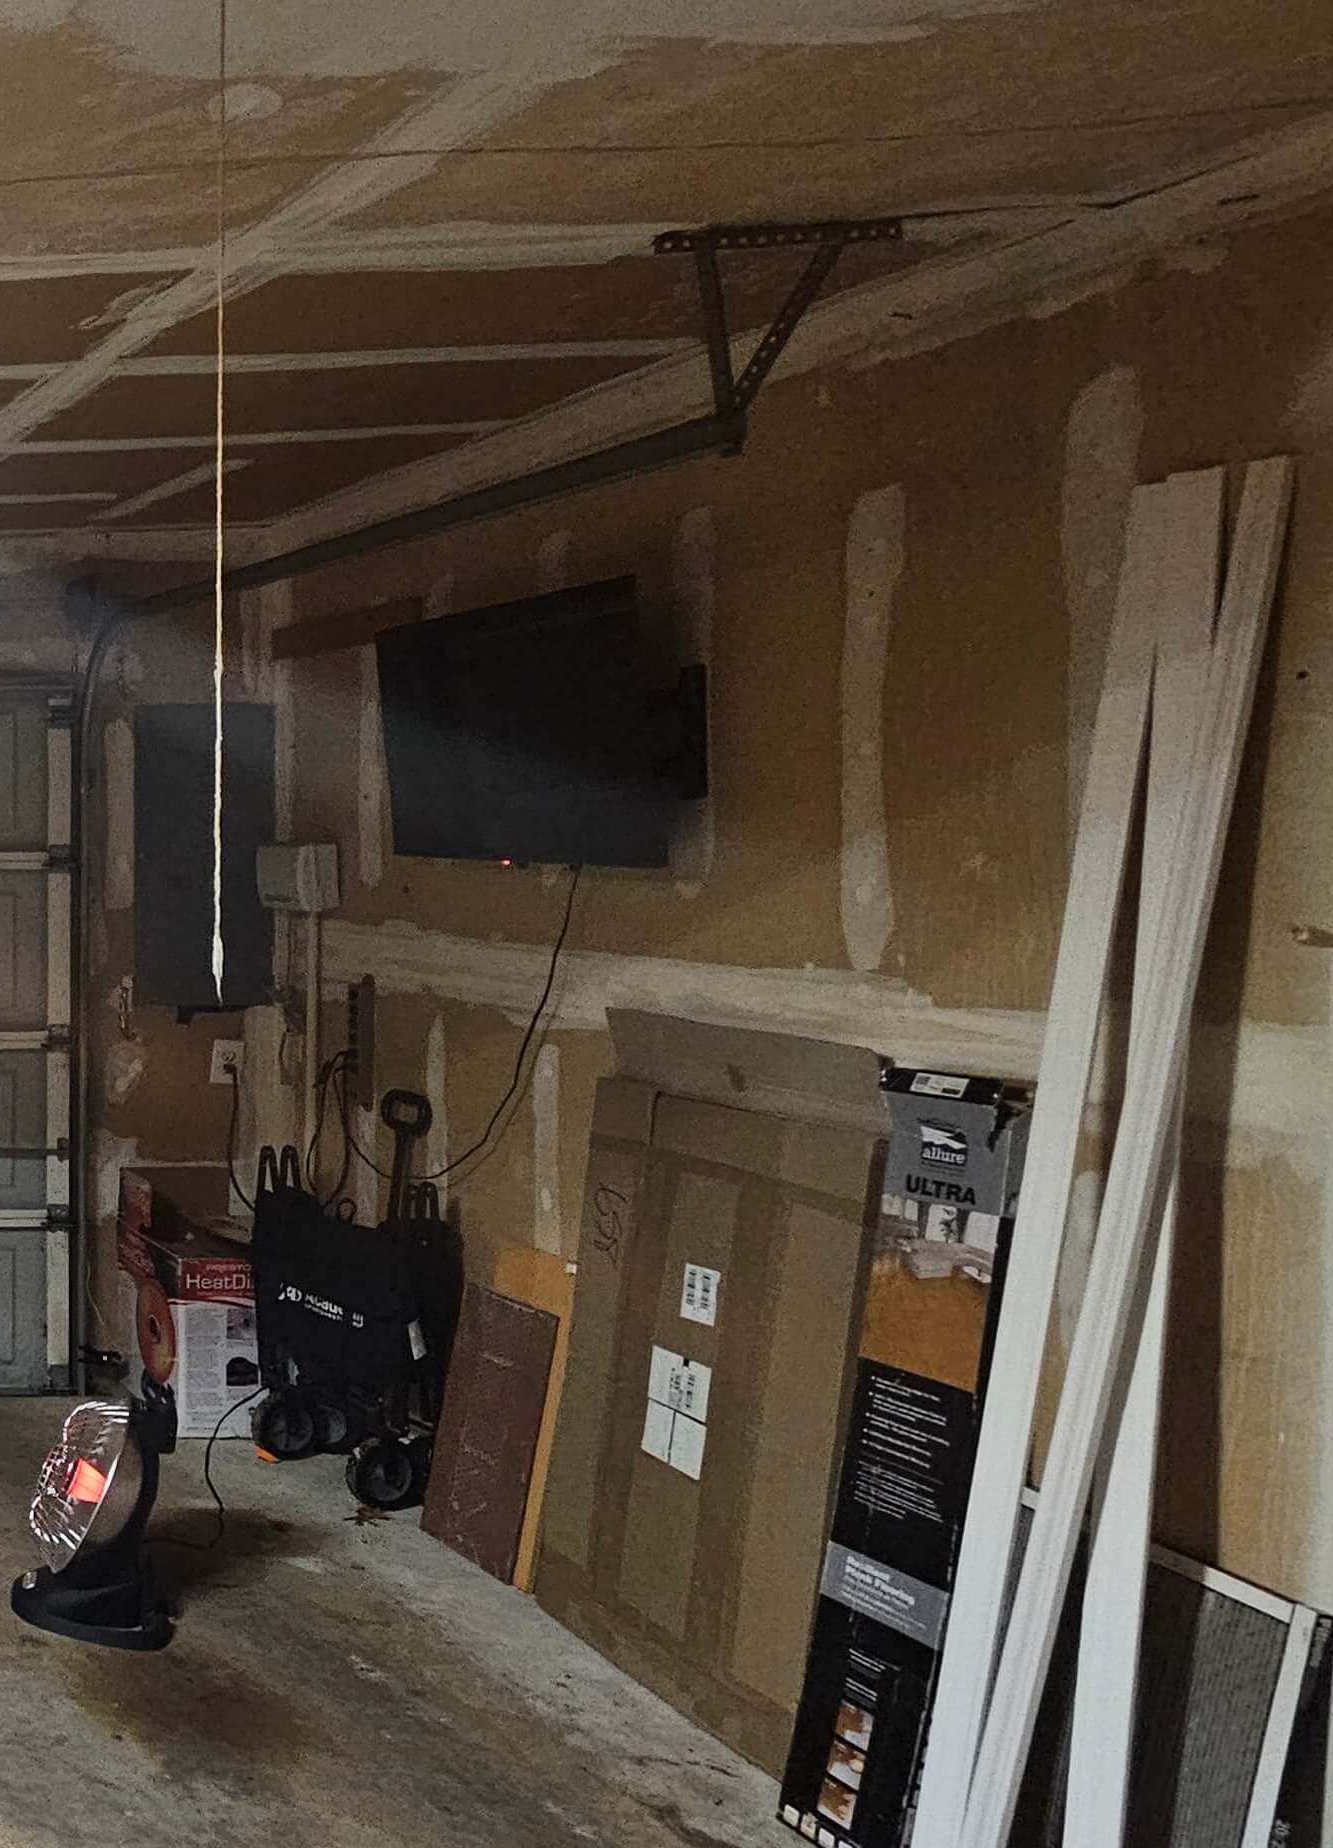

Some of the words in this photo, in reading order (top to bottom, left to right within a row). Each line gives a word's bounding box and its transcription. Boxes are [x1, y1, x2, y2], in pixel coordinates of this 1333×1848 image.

[922, 1146, 966, 1164] allure
[906, 1173, 976, 1206] ULTRA
[186, 1272, 255, 1290] HeatDi
